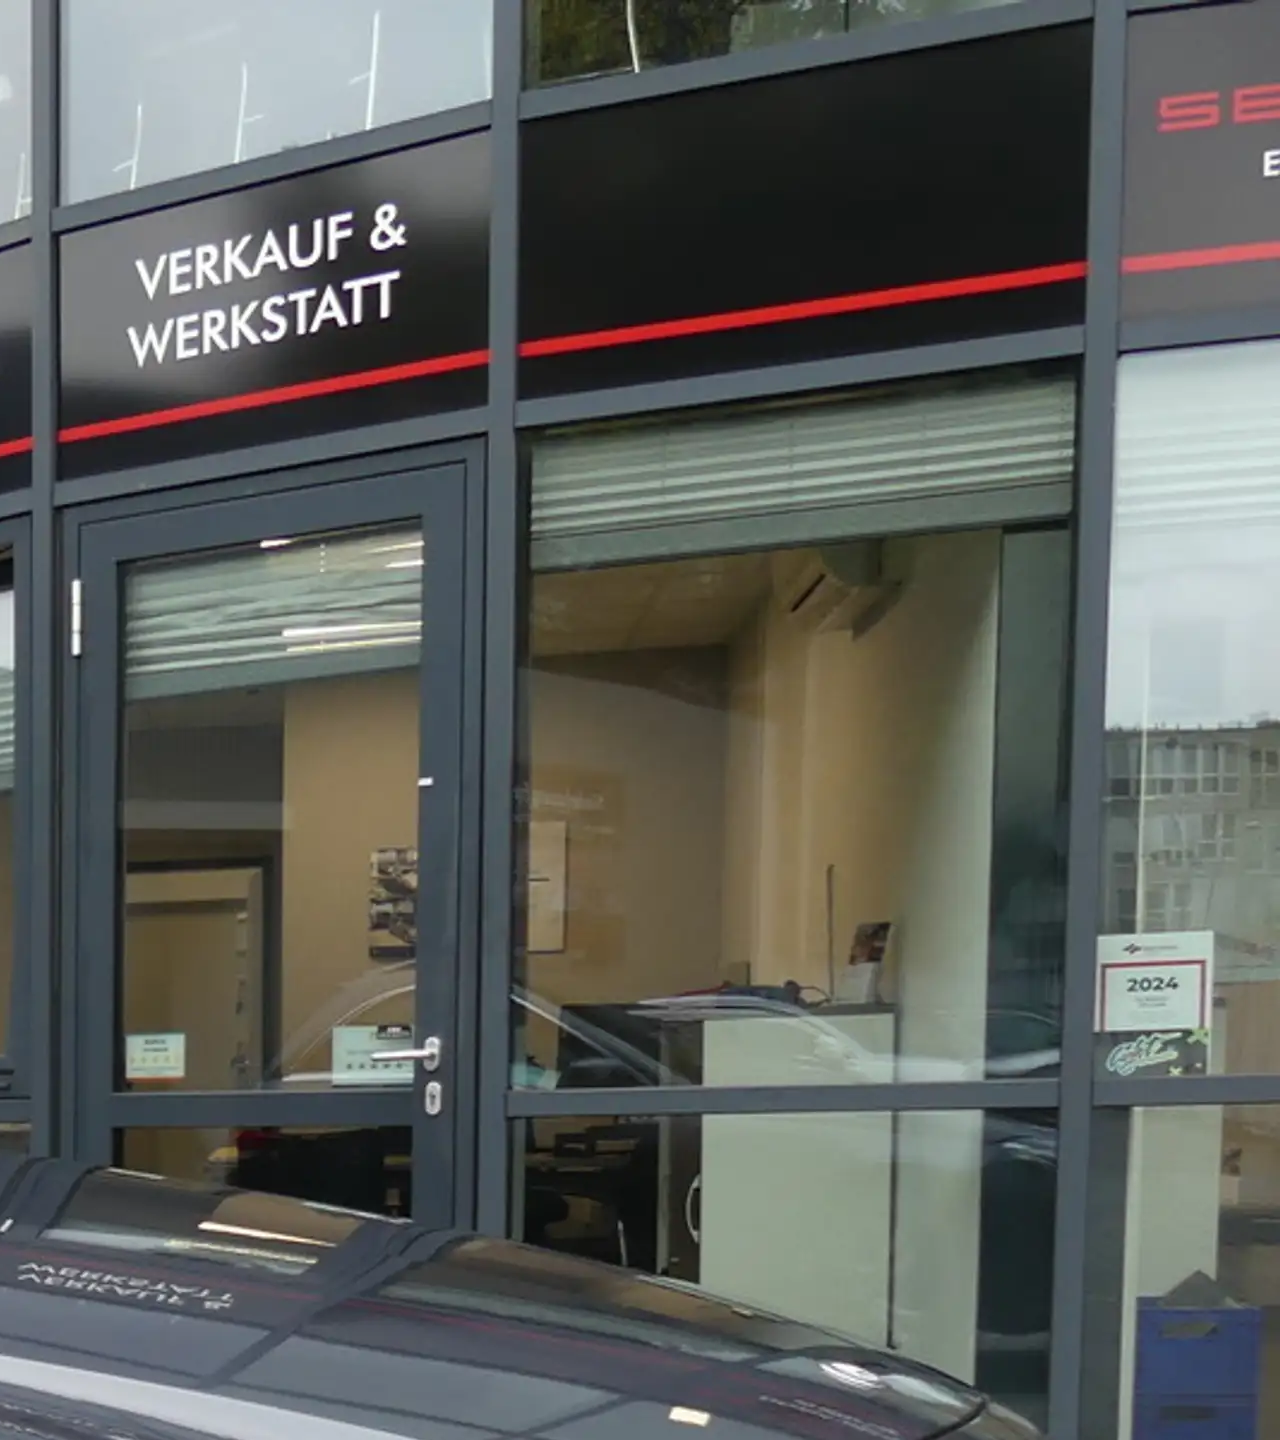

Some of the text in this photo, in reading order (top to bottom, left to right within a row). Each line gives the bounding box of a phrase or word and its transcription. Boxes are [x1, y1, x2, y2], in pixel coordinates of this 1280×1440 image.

[135, 203, 407, 301] VERKAUF &
[126, 269, 401, 368] WERKSTATT
[1126, 976, 1180, 993] 2024
